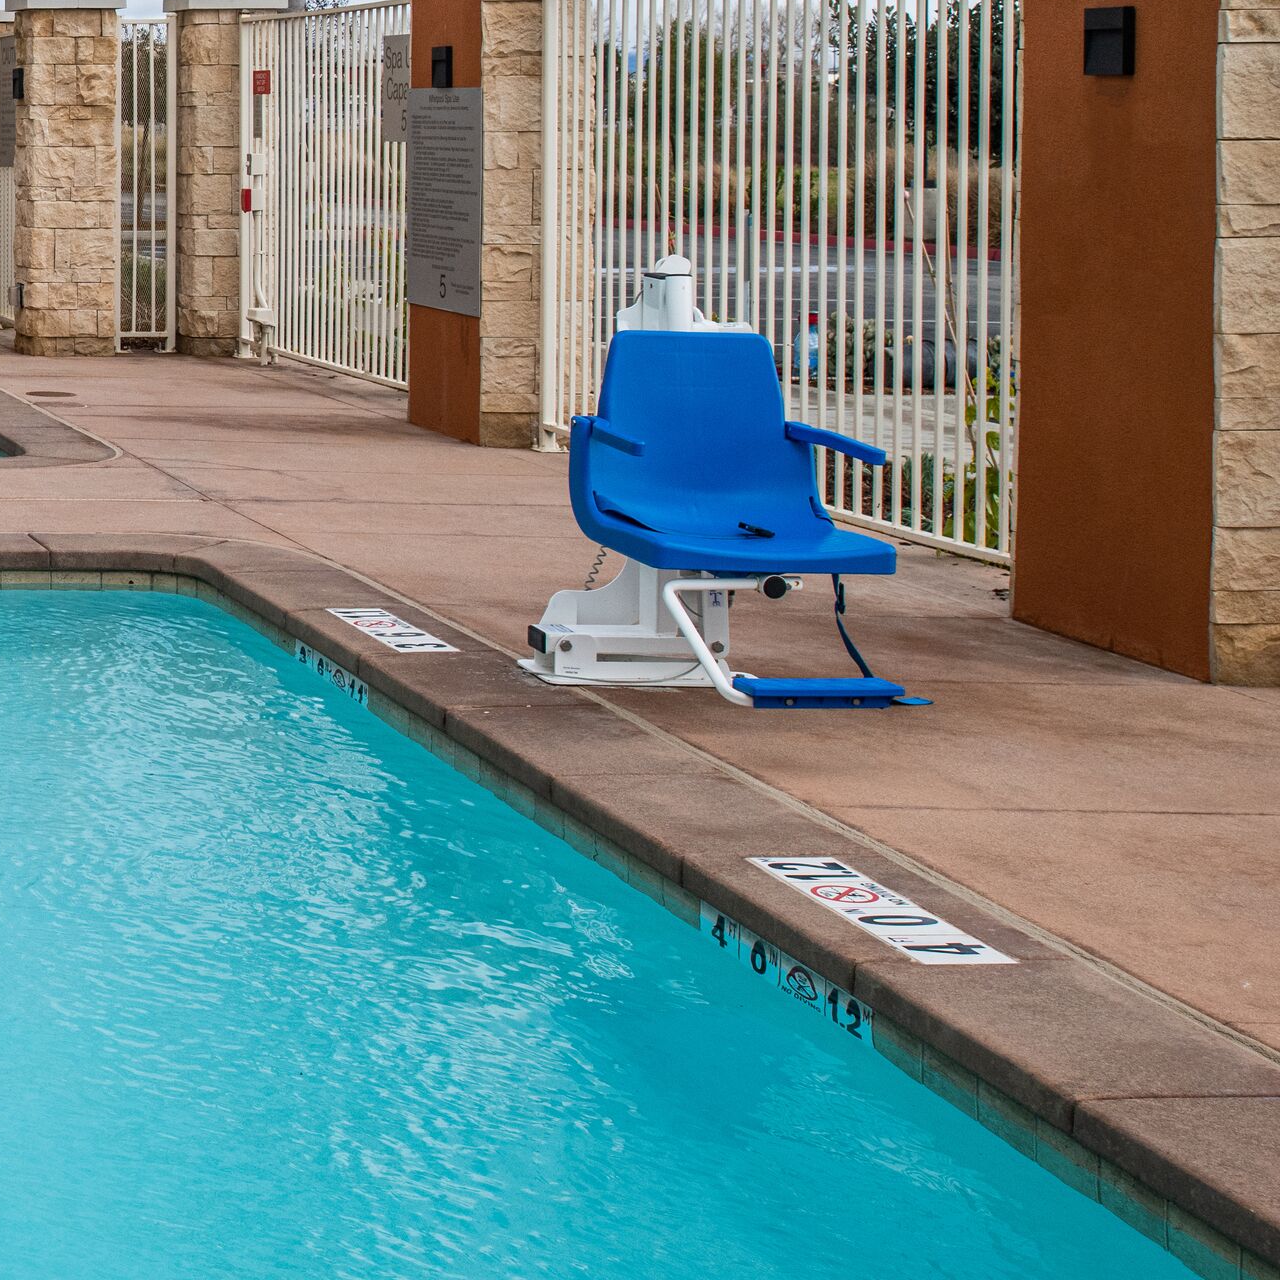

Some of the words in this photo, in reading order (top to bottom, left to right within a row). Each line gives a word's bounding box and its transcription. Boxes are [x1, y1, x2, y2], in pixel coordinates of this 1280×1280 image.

[385, 46, 402, 75] Spa
[440, 274, 446, 298] 5
[858, 915, 938, 926] 0
[902, 942, 986, 954] 4
[711, 914, 728, 948] 4
[726, 920, 737, 939] FT
[828, 988, 862, 1040] 1.2
[781, 985, 792, 995] NO
[794, 992, 822, 1014] DIVING
